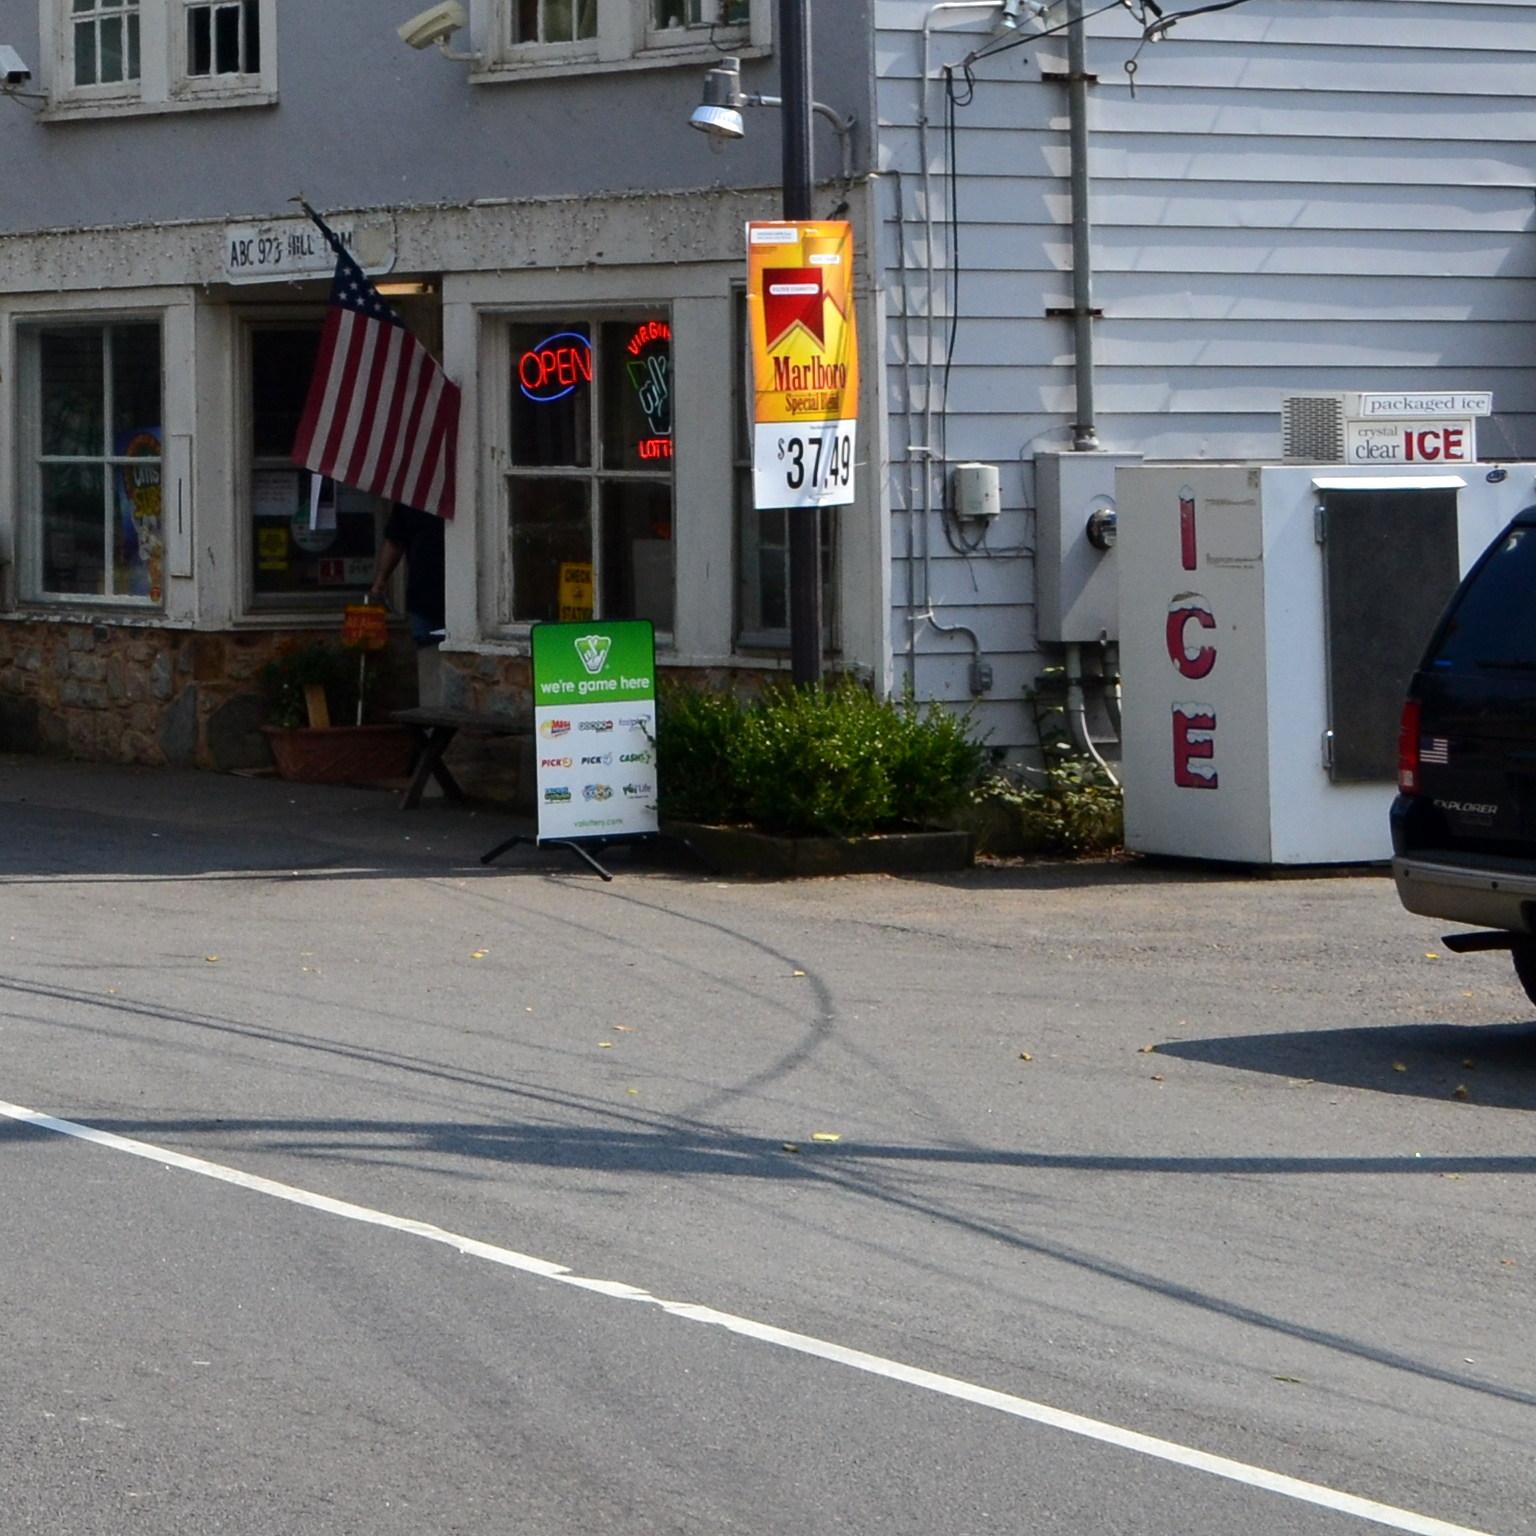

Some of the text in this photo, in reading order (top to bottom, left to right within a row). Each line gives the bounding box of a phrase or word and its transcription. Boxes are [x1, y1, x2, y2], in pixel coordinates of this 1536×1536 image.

[231, 240, 254, 266] ABC
[519, 349, 593, 388] OPEN
[773, 356, 846, 391] Marlboro
[785, 393, 818, 415] Special
[1371, 397, 1485, 413] packaged ice
[1356, 427, 1463, 460] clear ICE
[1358, 426, 1397, 438] crystal
[1166, 485, 1218, 789] ICE
[541, 676, 650, 695] we're game here
